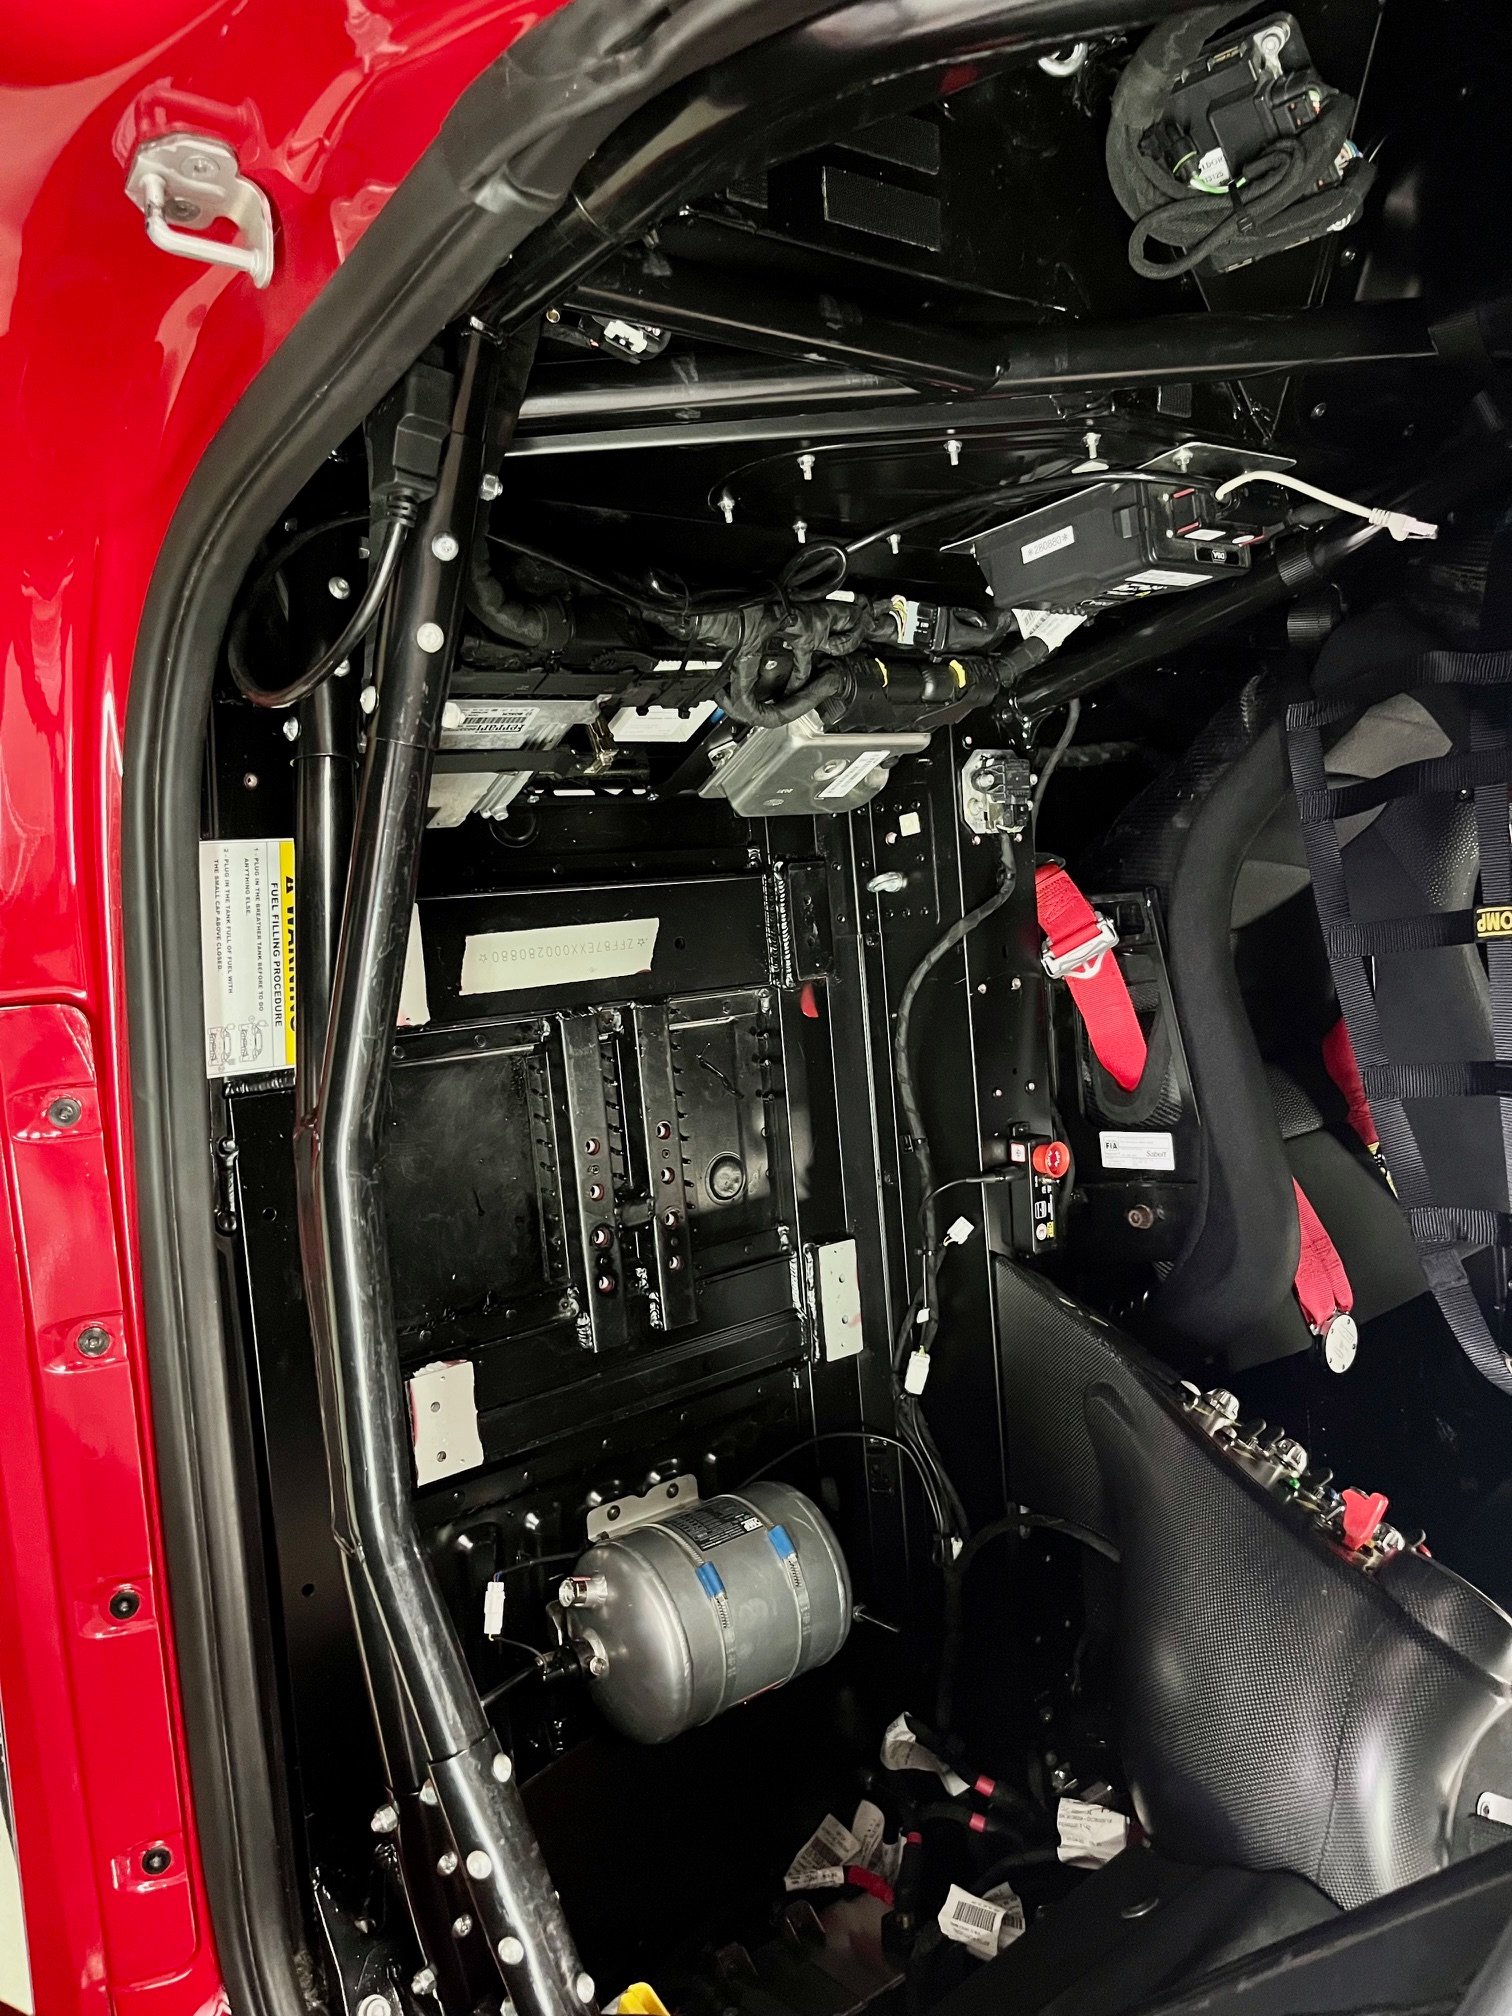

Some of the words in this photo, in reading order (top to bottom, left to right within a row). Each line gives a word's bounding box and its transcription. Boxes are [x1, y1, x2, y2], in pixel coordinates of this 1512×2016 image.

[475, 724, 525, 734] Ferrari
[1476, 911, 1512, 933] OMP
[272, 914, 280, 957] FILLING
[227, 946, 232, 954] OF
[491, 938, 634, 963] ZFF87EXX000280880
[258, 992, 264, 1000] TO
[274, 961, 282, 1026] PROCEDURE
[259, 1002, 264, 1011] DO
